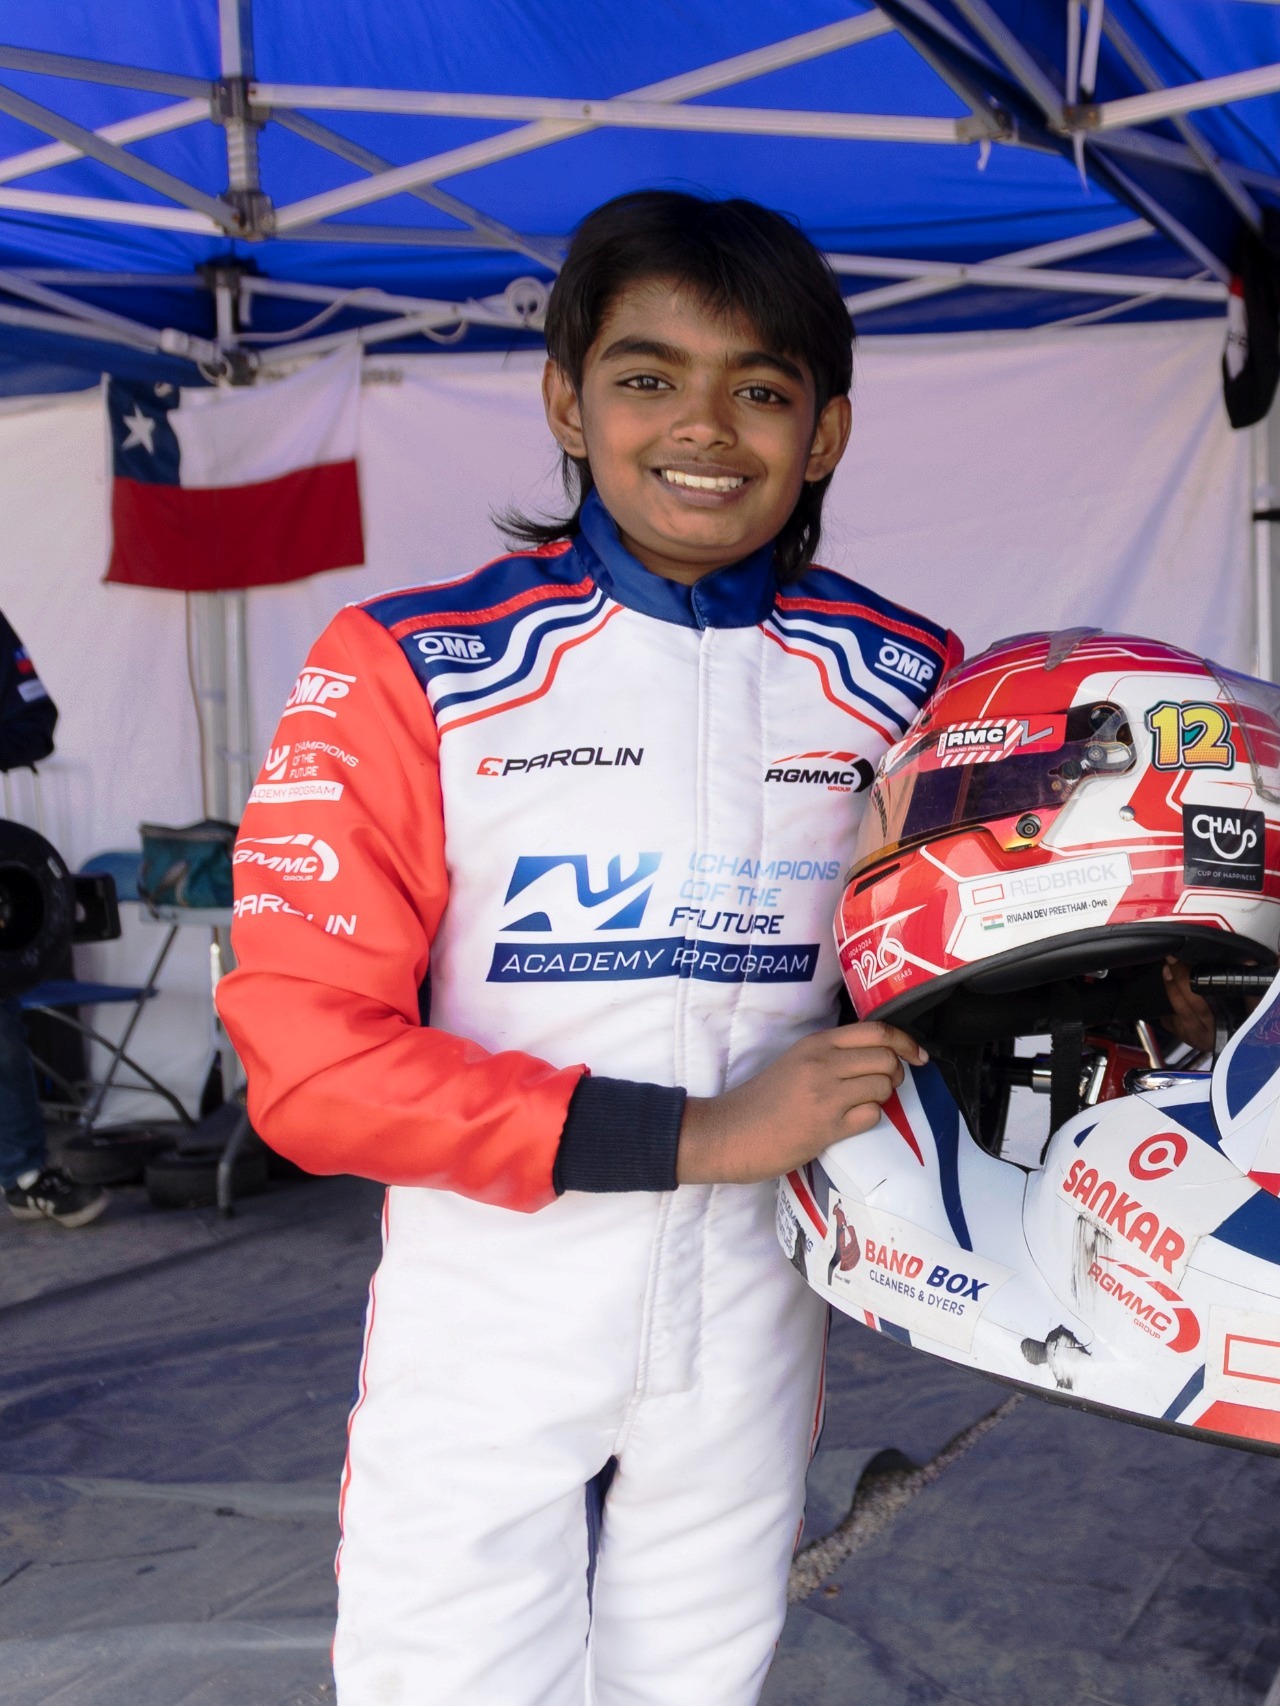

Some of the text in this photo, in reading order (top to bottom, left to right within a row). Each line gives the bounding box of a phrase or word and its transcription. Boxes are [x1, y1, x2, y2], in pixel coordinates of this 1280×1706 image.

[418, 637, 486, 658] OMP
[879, 645, 934, 682] OMP
[948, 728, 1004, 746] RMC
[1151, 702, 1234, 770] 12
[294, 740, 360, 767] CHAMPIONS
[502, 747, 644, 776] PAROLIN
[764, 769, 855, 785] RGMMC
[288, 785, 336, 797] PROGRAM
[689, 853, 841, 880] CHAMPIONS
[1010, 863, 1117, 897] REDBRICK
[1197, 870, 1211, 878] CUP
[1223, 872, 1256, 881] HAPPINESS
[737, 886, 782, 907] THE
[1006, 911, 1034, 924] RIVAAN
[1034, 908, 1048, 919] DEV
[1049, 901, 1088, 916] PREETHAM
[501, 948, 665, 974] ACADEMY
[851, 937, 906, 992] 120
[893, 968, 913, 982] YEARS
[1062, 1159, 1186, 1274] SANKAR
[865, 1239, 924, 1279] BAND
[926, 1265, 989, 1301] BOX
[869, 1269, 965, 1316] CLEANERS & DYERS
[1087, 1262, 1172, 1331] RGMMC
[1133, 1318, 1161, 1339] GROUP
